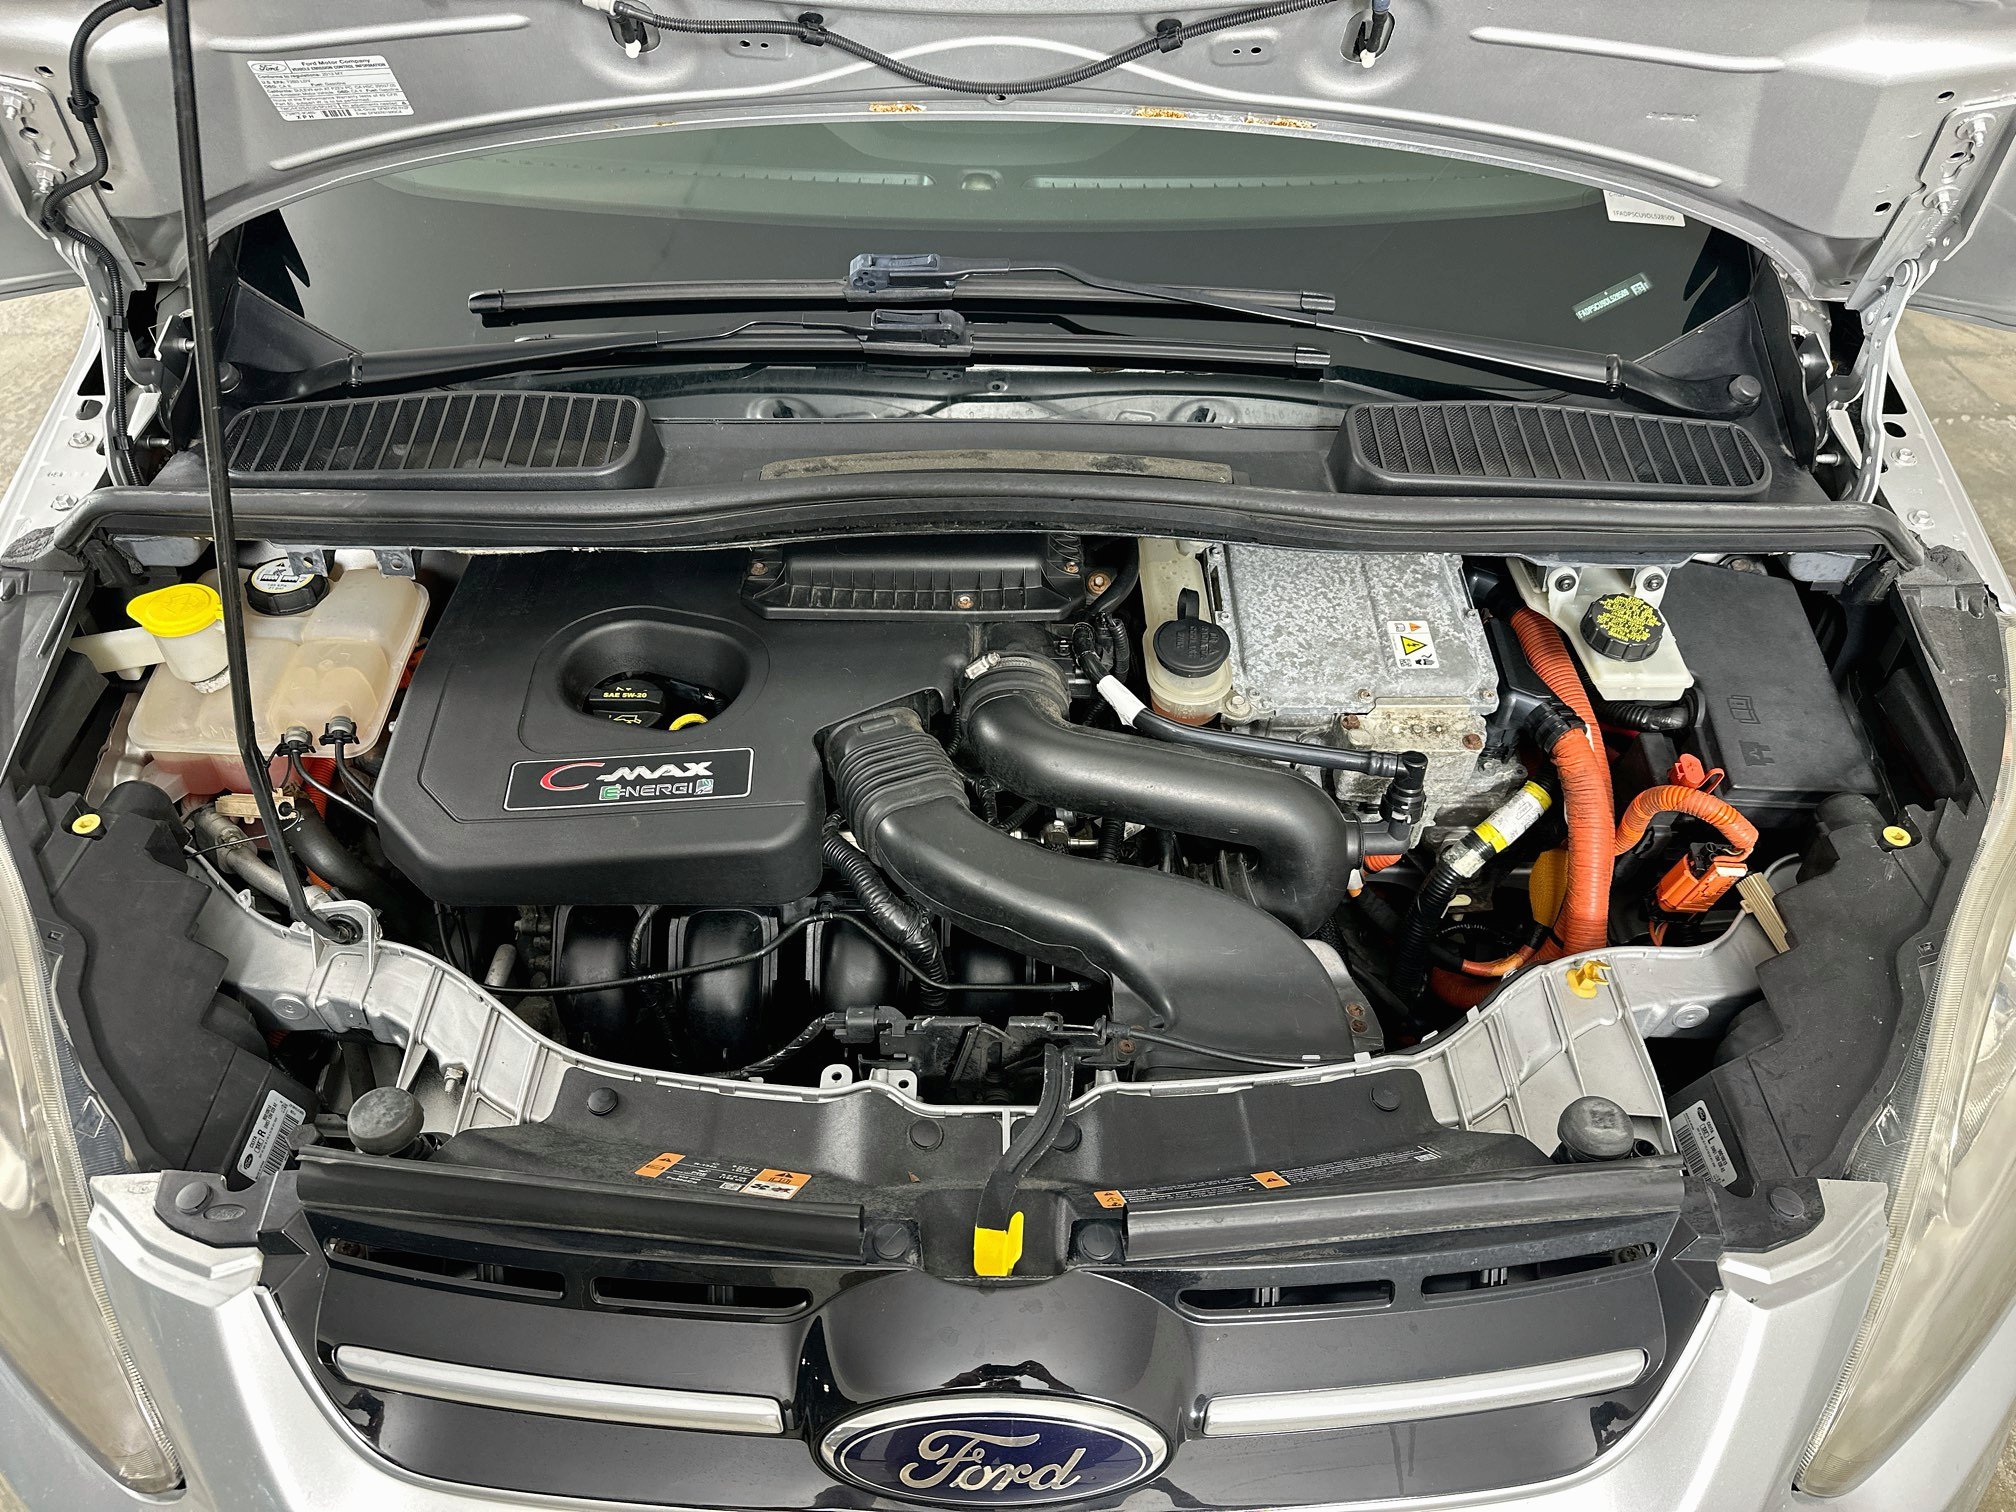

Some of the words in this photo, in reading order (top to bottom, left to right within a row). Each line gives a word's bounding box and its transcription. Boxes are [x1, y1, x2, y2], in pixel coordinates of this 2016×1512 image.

[257, 1129, 266, 1137] R
[1708, 1136, 1716, 1145] L
[898, 1429, 1087, 1491] Ford
